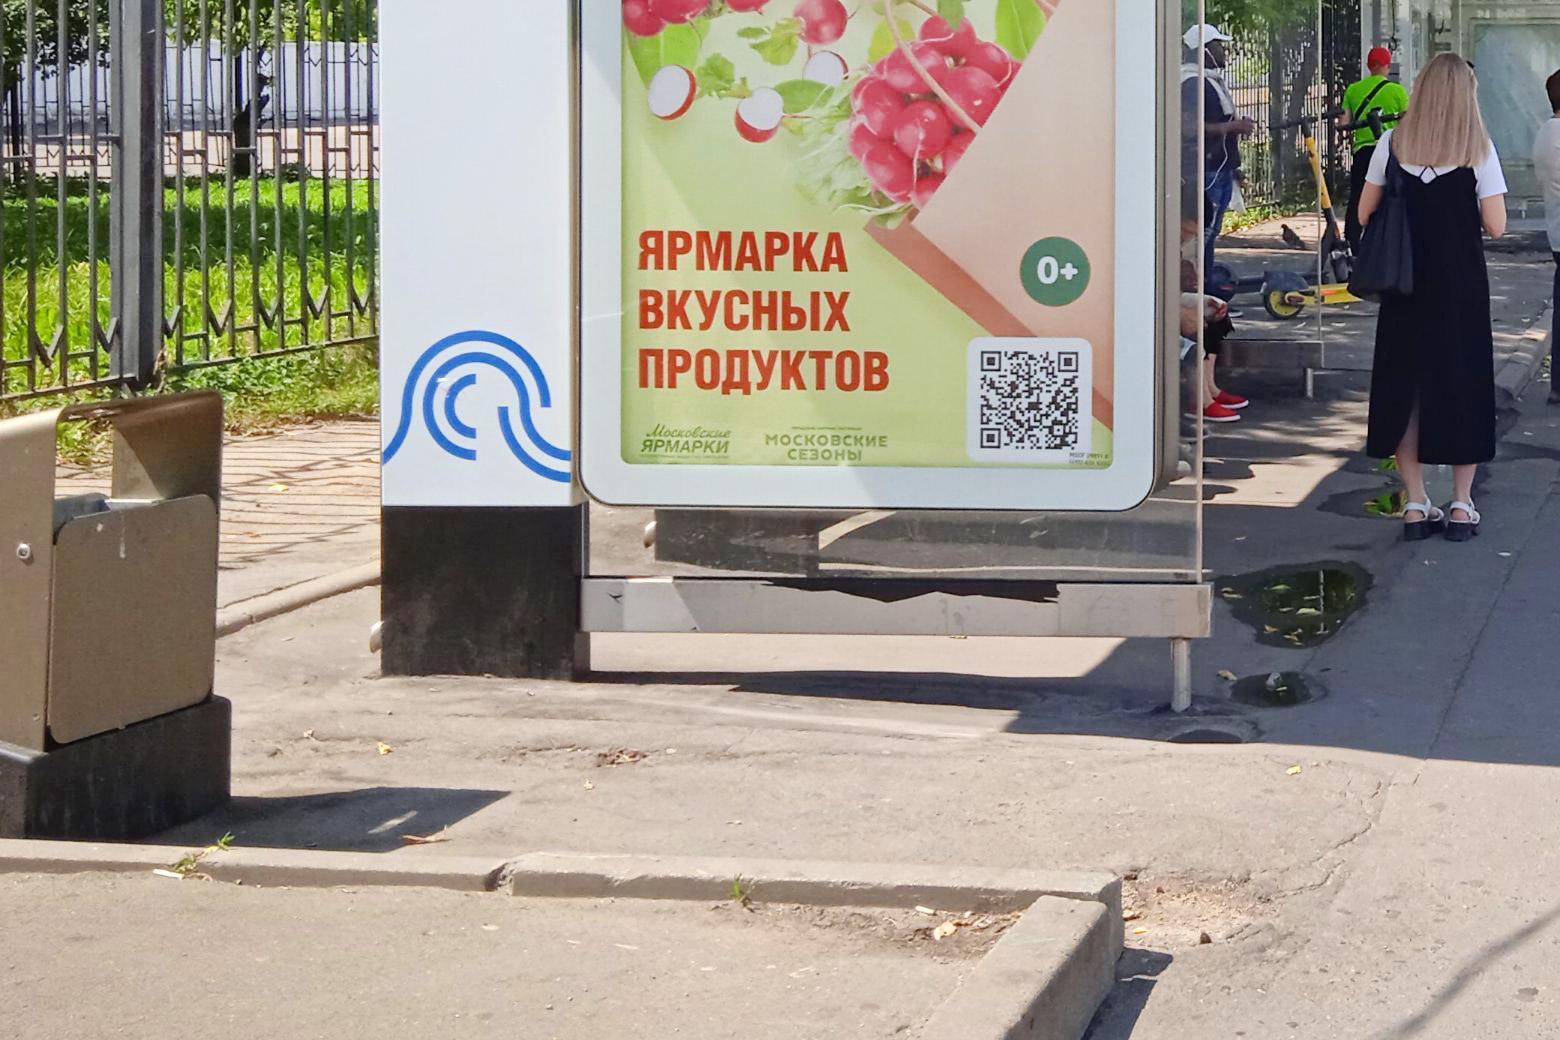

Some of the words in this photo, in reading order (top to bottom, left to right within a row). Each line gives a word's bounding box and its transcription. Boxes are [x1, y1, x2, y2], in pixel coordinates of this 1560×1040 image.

[637, 230, 849, 273] ЯРМАРКА
[1036, 255, 1079, 285] 0+
[637, 288, 852, 332] ВКУСНЫХ
[637, 347, 890, 396] ПРОДУКТОВ
[645, 423, 733, 439] Московские
[764, 433, 889, 448] МОСКОВСКИЕ
[640, 439, 730, 454] ЯРМАРКИ
[786, 448, 863, 462] СЕЗОНЫ
